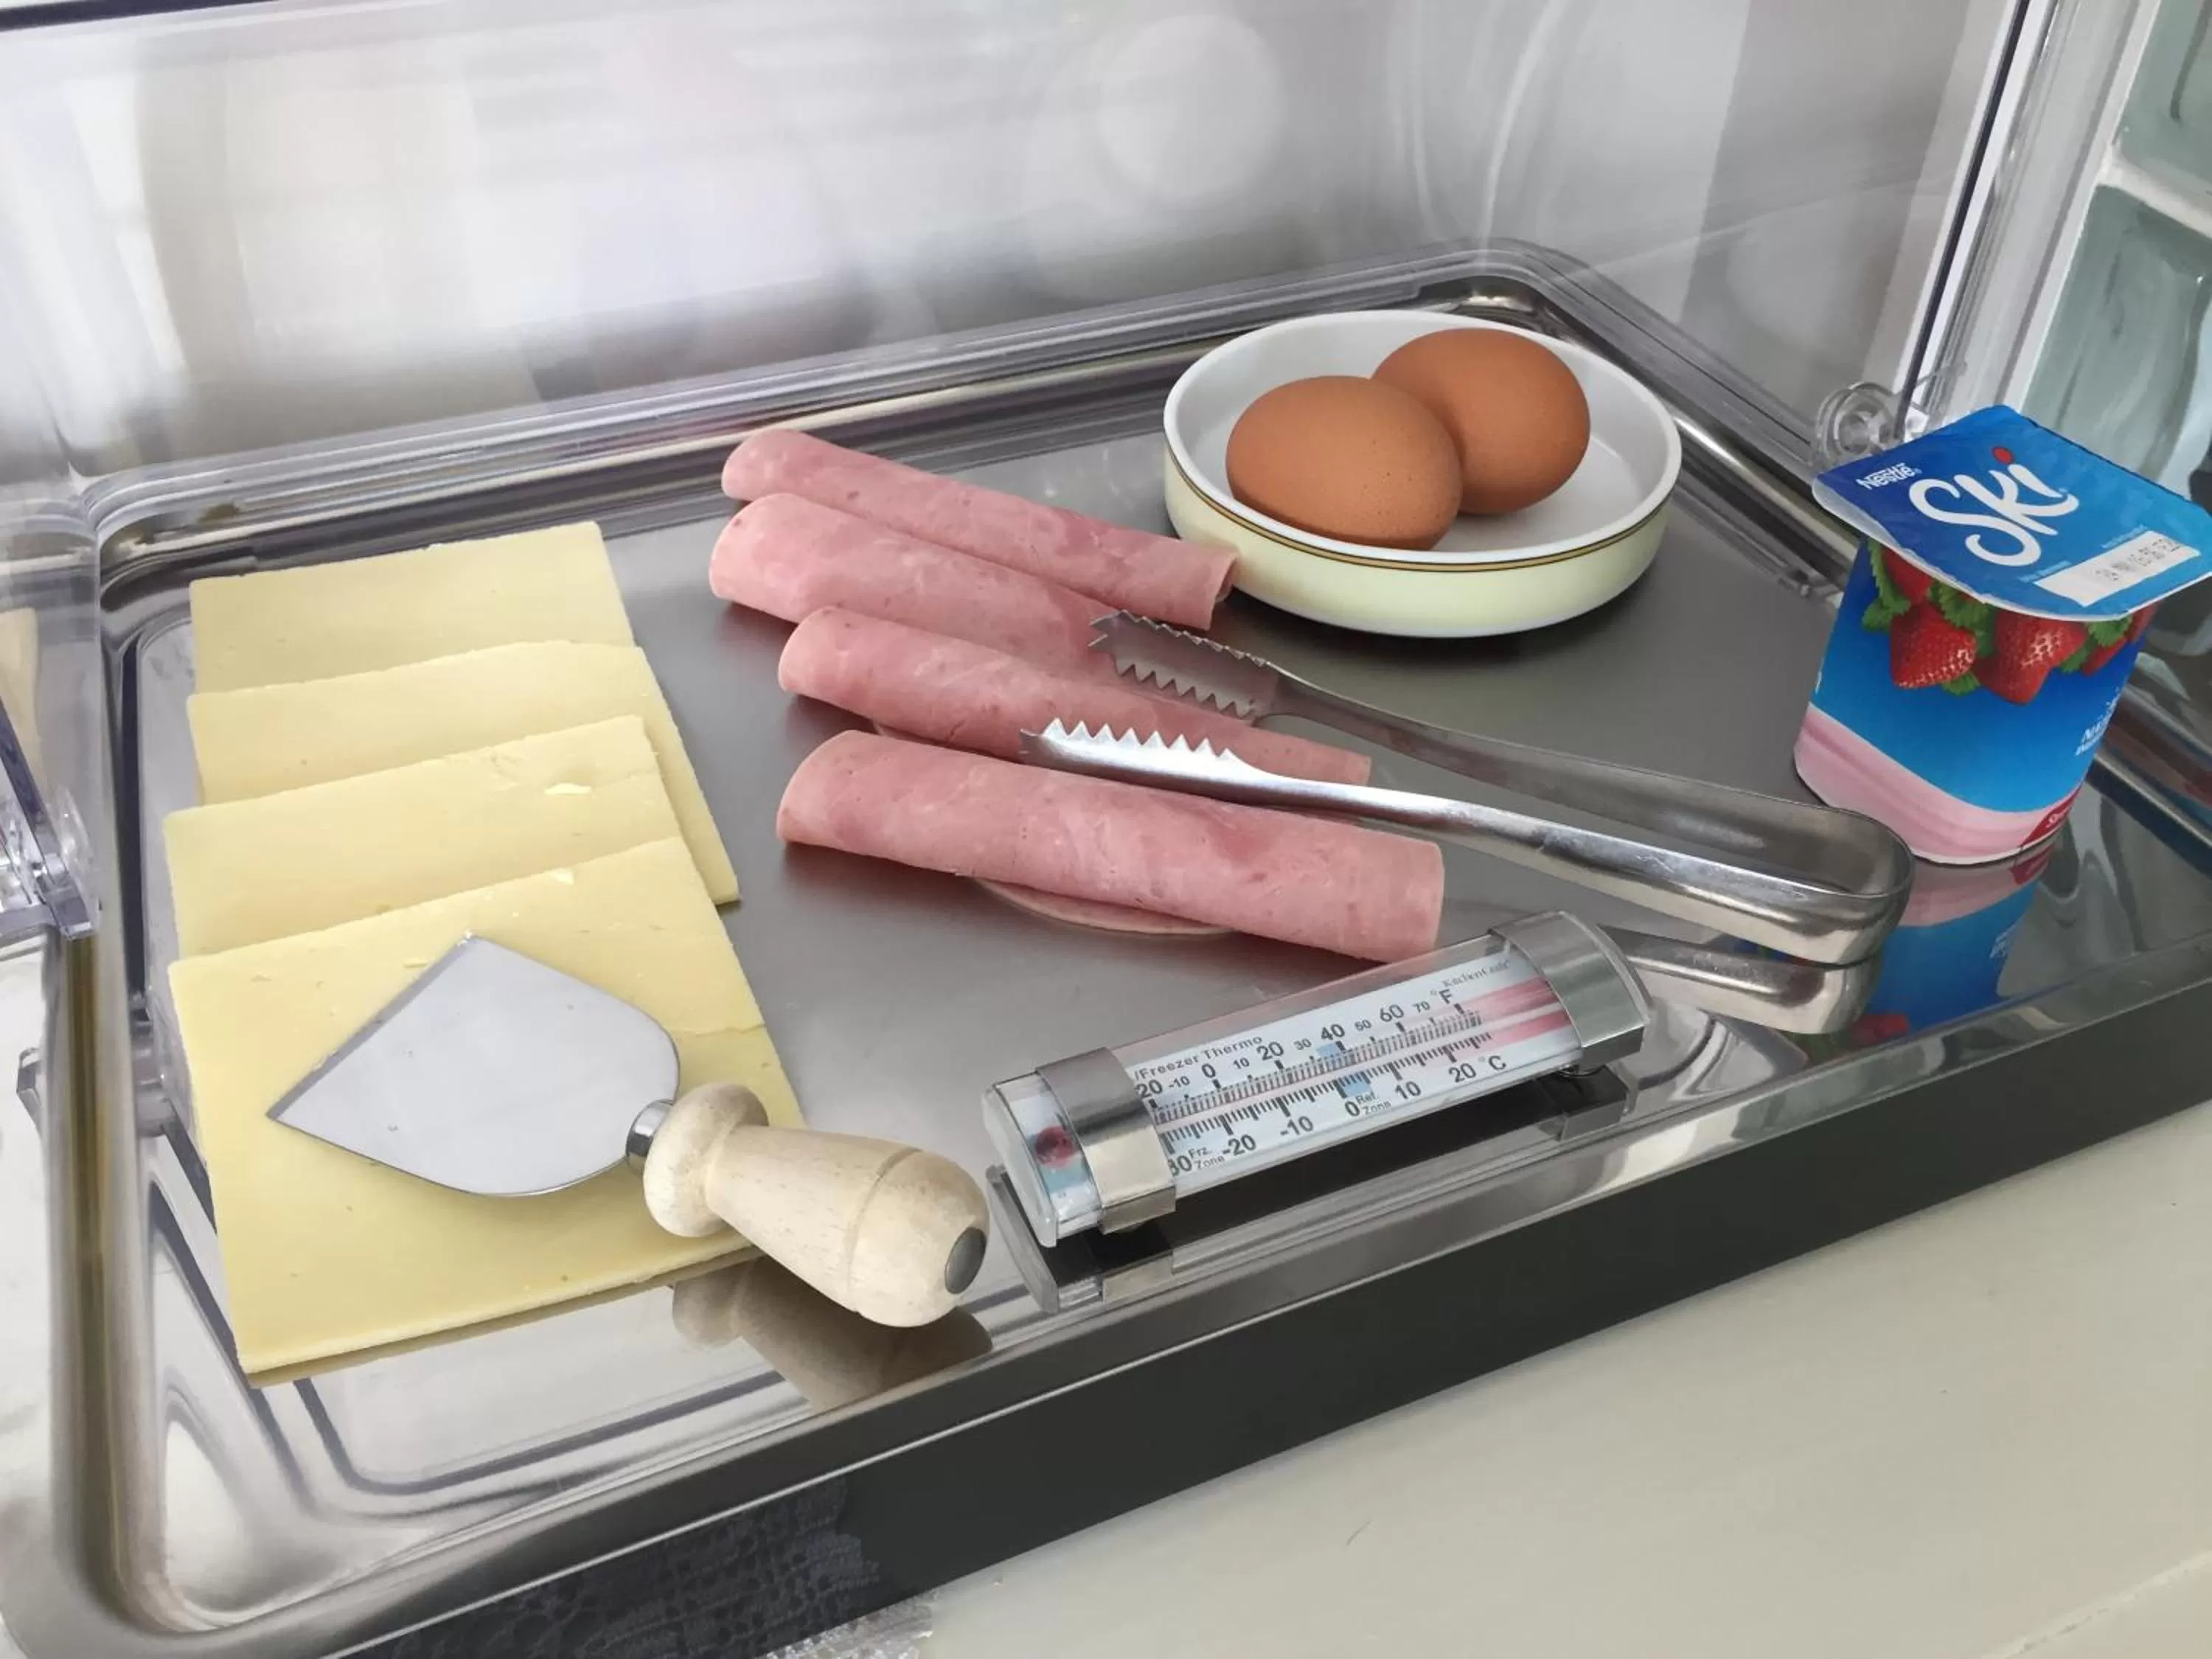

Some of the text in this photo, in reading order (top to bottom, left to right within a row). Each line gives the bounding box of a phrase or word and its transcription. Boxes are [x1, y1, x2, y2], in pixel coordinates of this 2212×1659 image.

[1168, 1076, 1191, 1089] -10
[1201, 1063, 1217, 1079] 0
[1233, 1057, 1251, 1070] 10
[1256, 1041, 1284, 1061] 20
[1293, 1038, 1312, 1051] 30
[1320, 1023, 1346, 1041] 40
[1354, 1019, 1372, 1032] 50
[1379, 1004, 1405, 1023] 60
[1412, 1001, 1431, 1014] 70
[1203, 1036, 1264, 1060] Thermo
[1394, 1080, 1422, 1101] 10
[1448, 1062, 1478, 1084] 20
[1222, 1100, 1361, 1157] -20 -10 0
[1193, 1155, 1225, 1171] Zone
